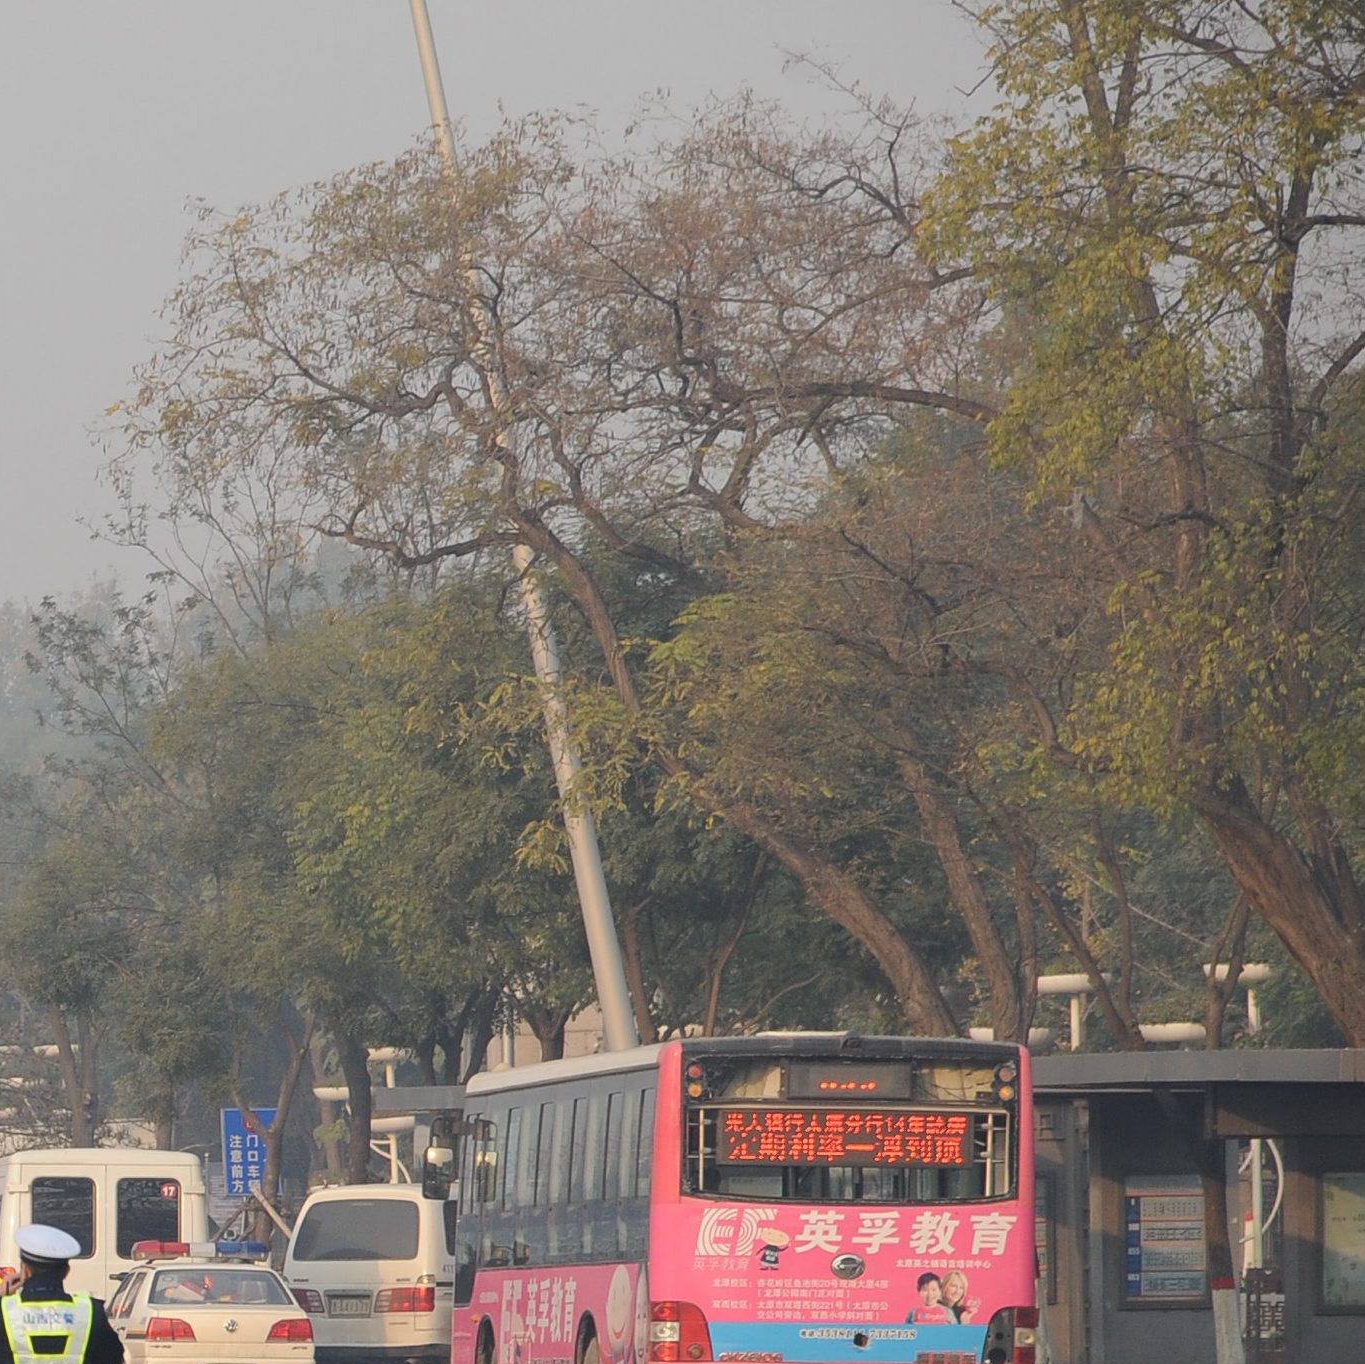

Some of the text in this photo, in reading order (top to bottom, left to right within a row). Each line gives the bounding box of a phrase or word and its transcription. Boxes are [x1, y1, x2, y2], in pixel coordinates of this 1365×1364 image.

[229, 1134, 244, 1193] 注意前方
[162, 1186, 175, 1197] 17
[695, 1208, 779, 1256] EF
[794, 1210, 1017, 1256] 英孚教育
